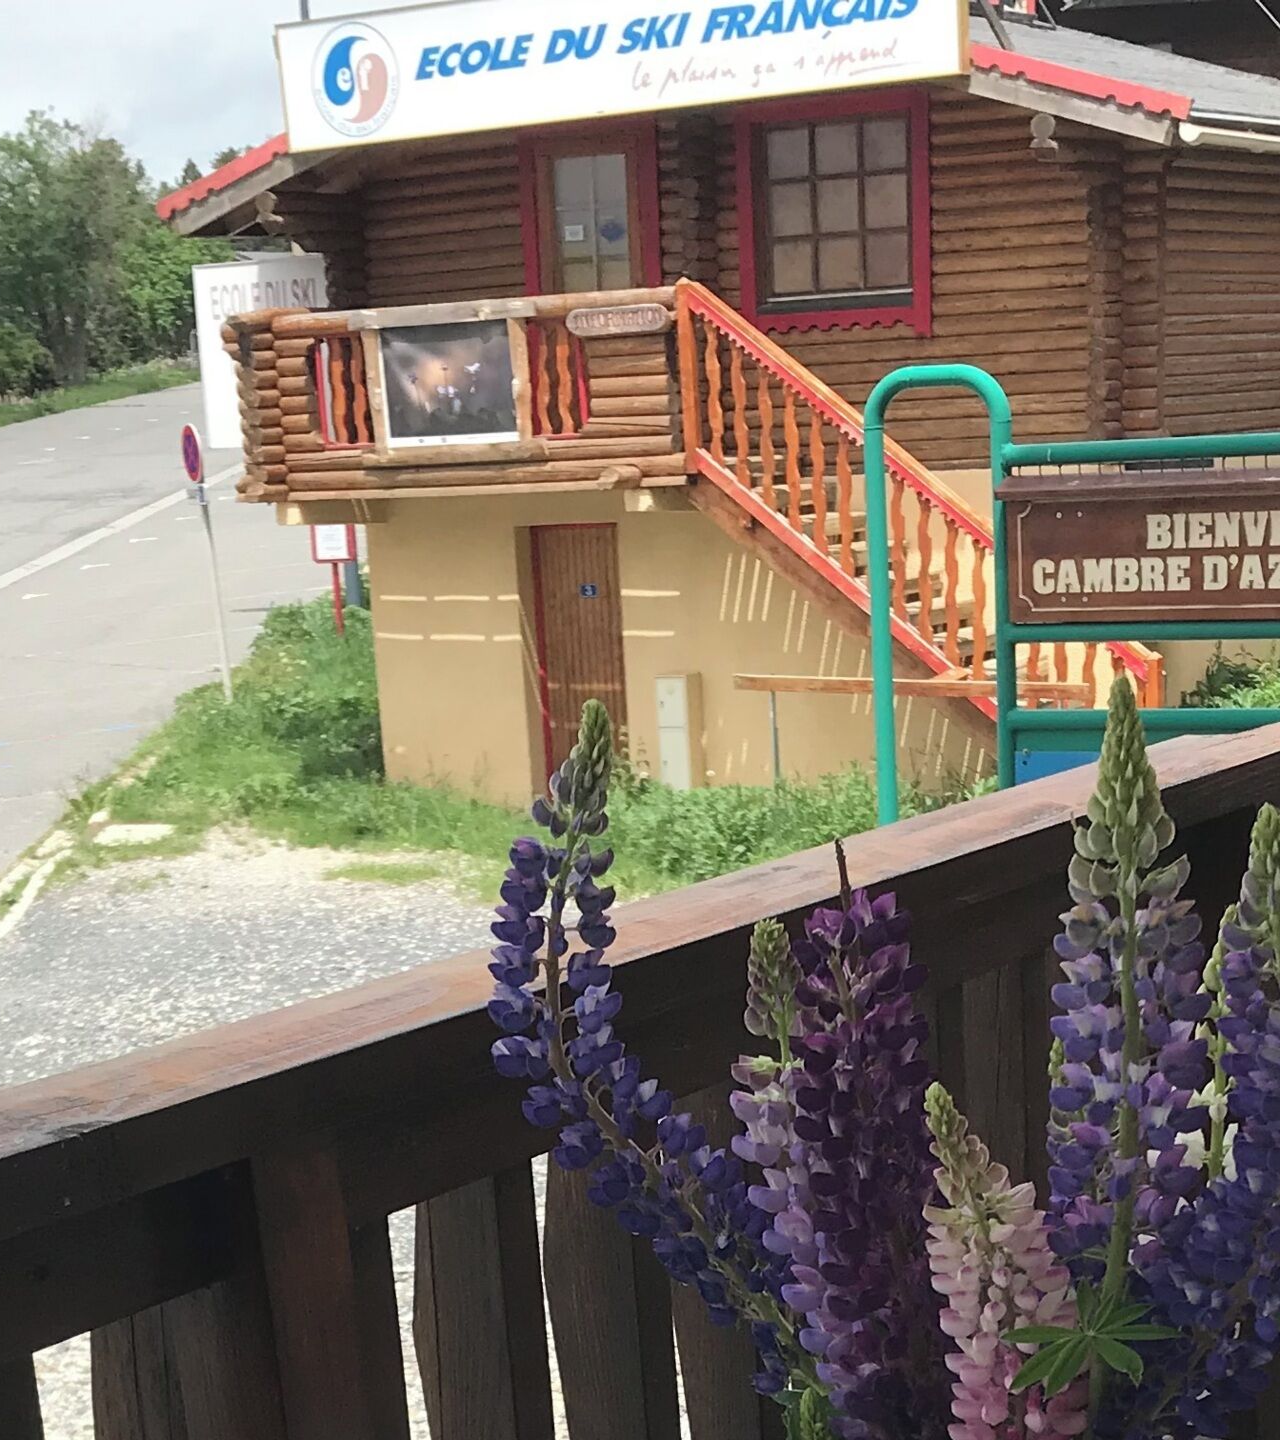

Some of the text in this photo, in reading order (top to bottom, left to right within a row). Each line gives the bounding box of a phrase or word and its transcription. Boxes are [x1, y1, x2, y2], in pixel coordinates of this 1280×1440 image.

[415, 33, 534, 80] ECOLE
[543, 23, 608, 64] DU
[616, 12, 692, 54] SKI
[1031, 553, 1191, 594] CAMBRE
